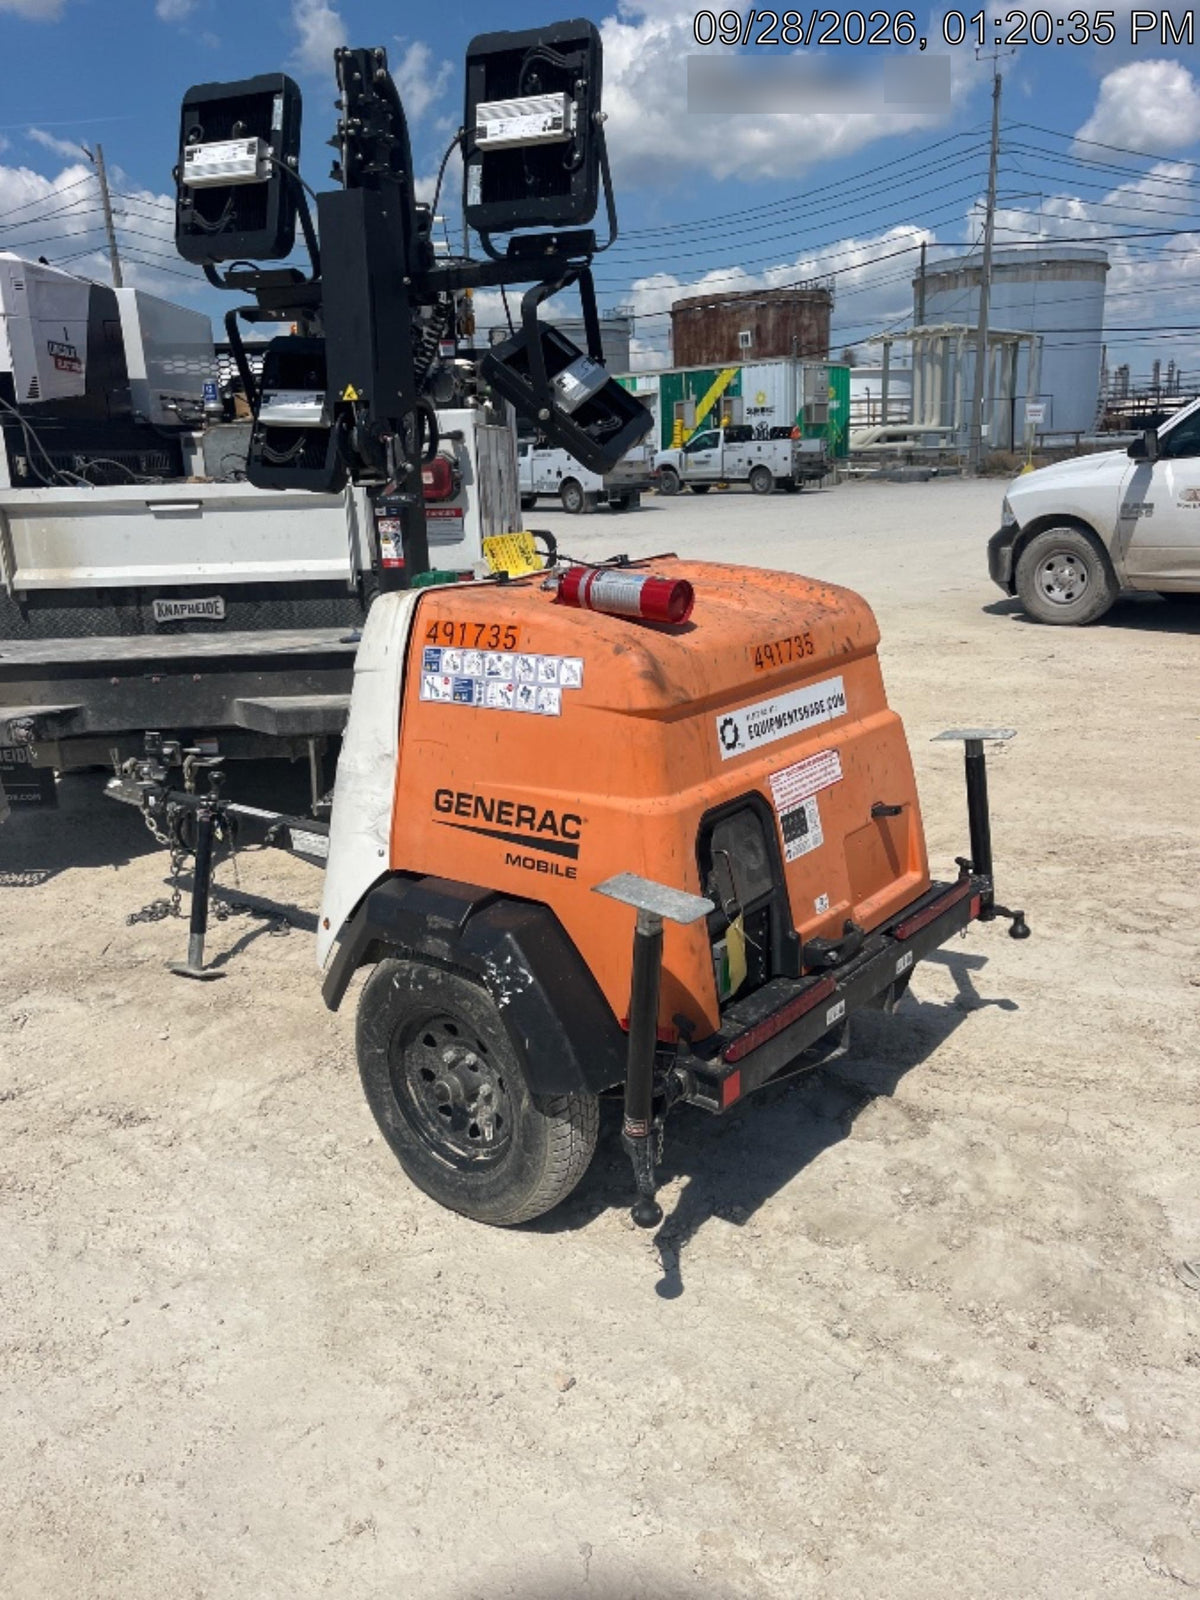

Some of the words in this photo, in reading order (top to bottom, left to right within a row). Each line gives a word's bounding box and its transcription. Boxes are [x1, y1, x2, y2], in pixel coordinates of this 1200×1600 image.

[156, 600, 221, 617] KNAPHEIDE
[426, 620, 518, 650] 491735
[755, 632, 815, 669] 491735
[434, 788, 582, 840] GENERAC
[505, 852, 577, 879] MOBILE
